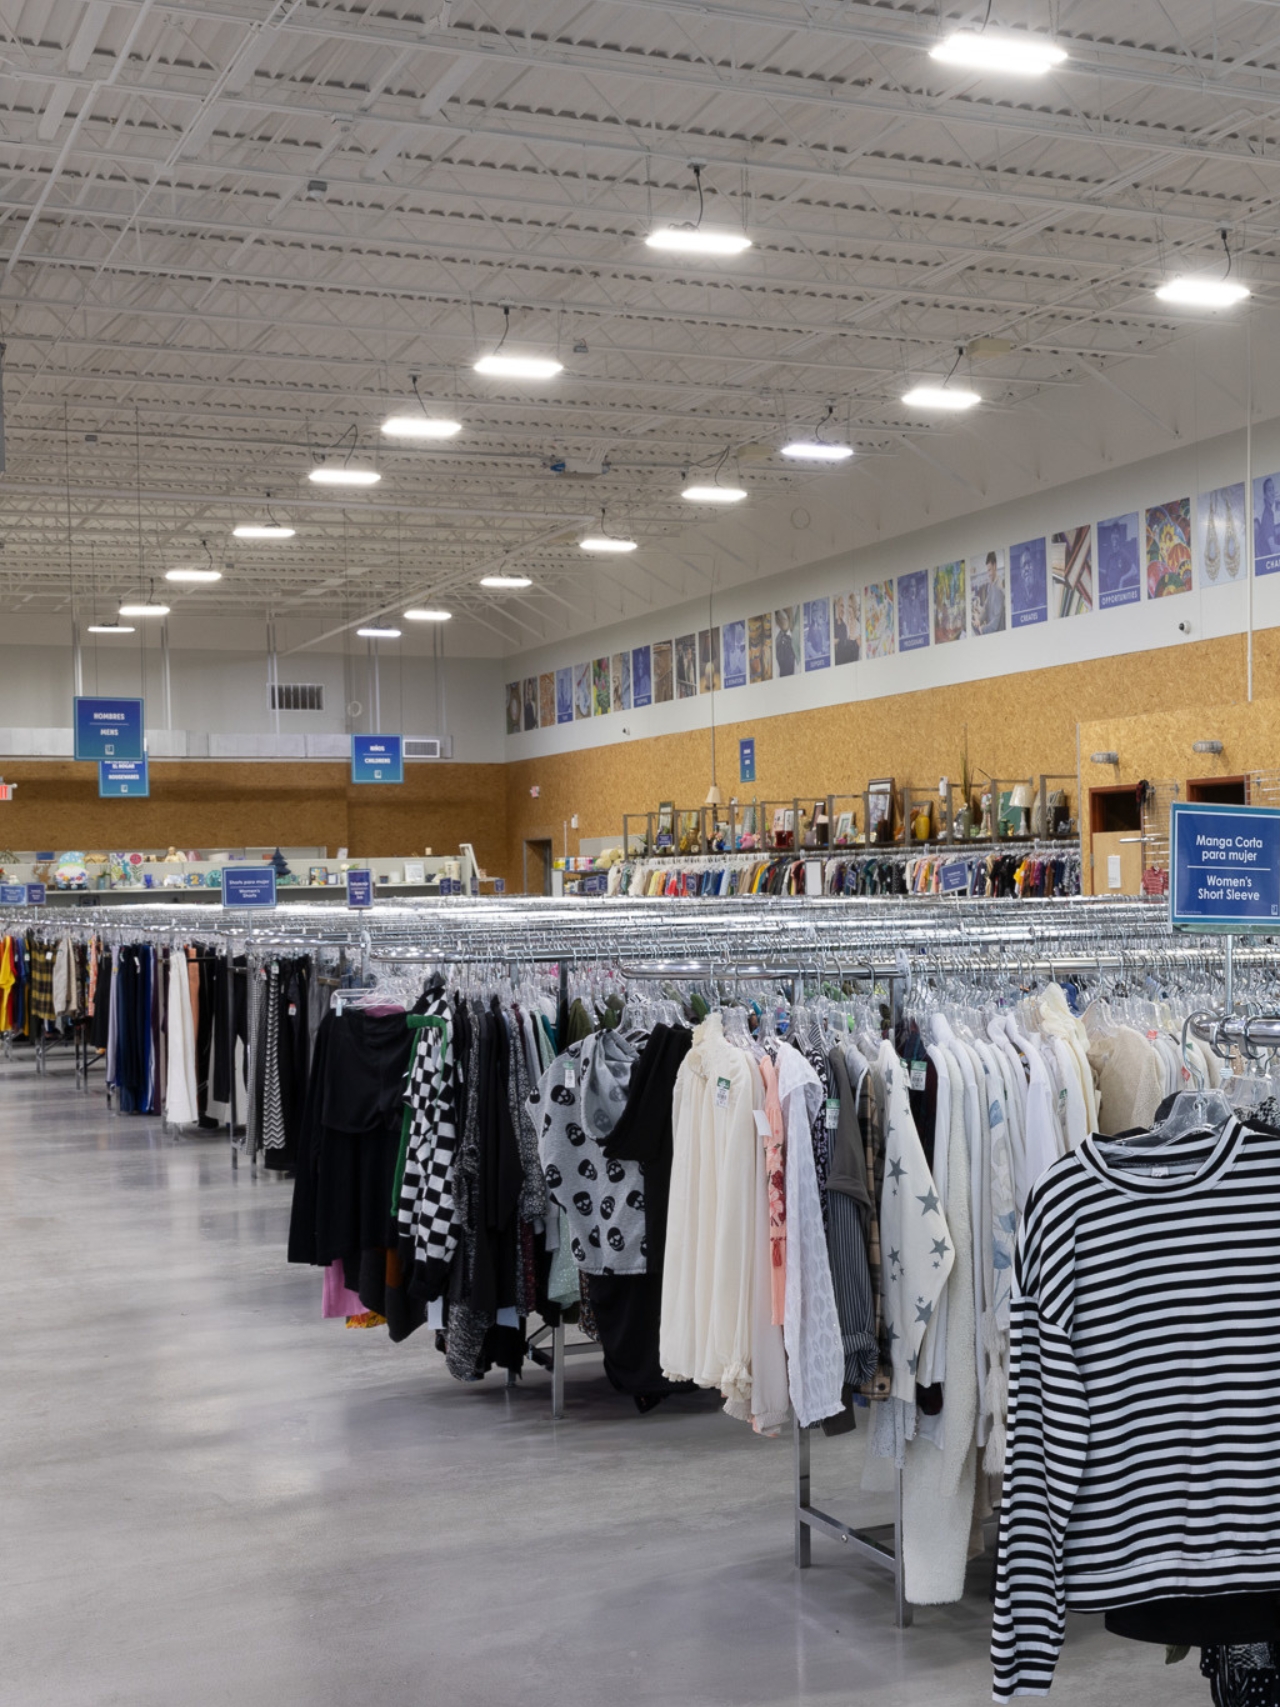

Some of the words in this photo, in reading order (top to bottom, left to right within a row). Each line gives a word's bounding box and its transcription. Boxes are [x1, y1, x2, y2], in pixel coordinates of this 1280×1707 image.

[1101, 590, 1138, 606] OPPORTUNITIES
[93, 712, 125, 721] HOMBRES
[100, 728, 119, 736] MENS
[1195, 834, 1233, 850] Manga
[1234, 836, 1264, 849] Corta
[1201, 850, 1226, 862] para
[1228, 850, 1258, 863] mujer
[1206, 875, 1252, 888] Women's
[1197, 888, 1224, 900] Short
[1225, 888, 1261, 901] Sleeve
